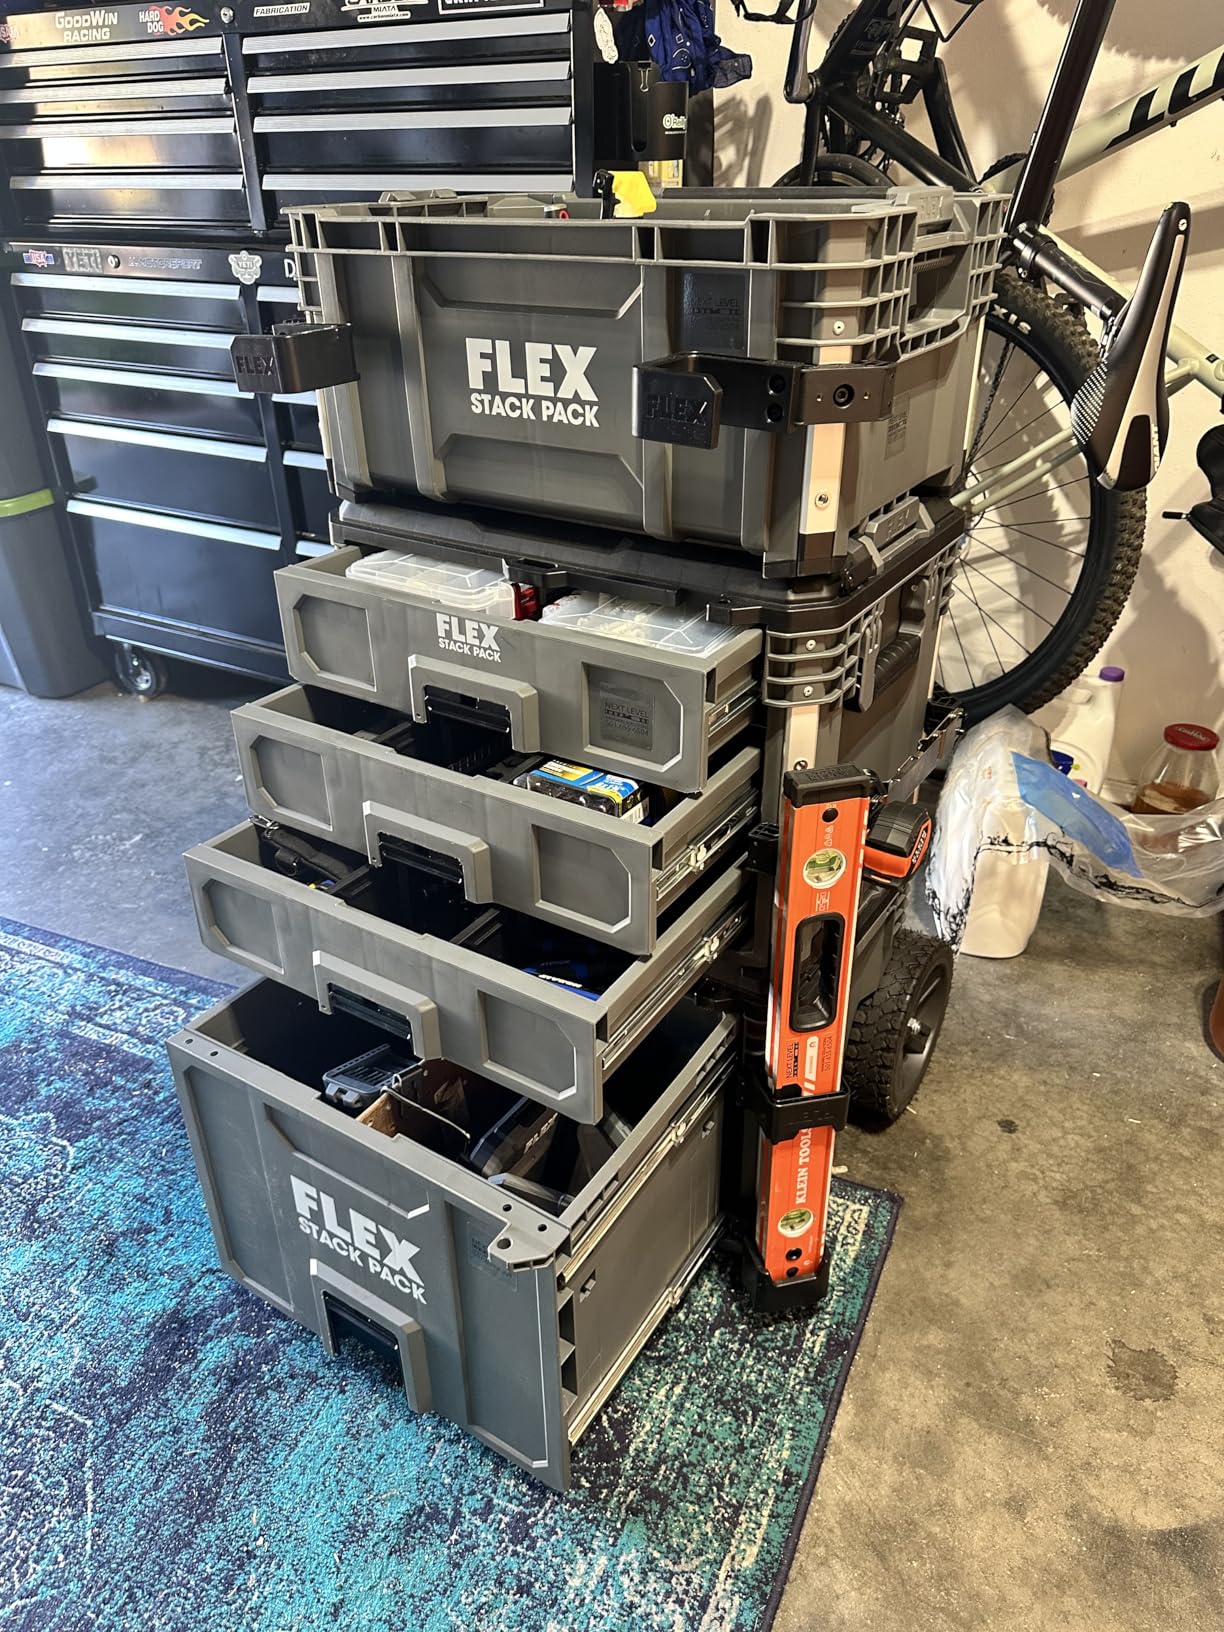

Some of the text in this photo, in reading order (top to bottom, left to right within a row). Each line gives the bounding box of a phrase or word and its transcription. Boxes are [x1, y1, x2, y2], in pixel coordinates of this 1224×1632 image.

[138, 10, 160, 23] HARD
[255, 5, 308, 16] FABRICATION
[373, 5, 396, 13] MIATA
[63, 28, 111, 42] RACING
[147, 21, 164, 33] DOG
[64, 251, 101, 270] YETI
[238, 260, 253, 269] YETI
[236, 354, 275, 376] FLEX
[465, 337, 599, 402] FLEX
[470, 392, 600, 428] STACK PACK
[436, 612, 500, 651] FLEX
[438, 637, 502, 663] STACK PACK
[795, 1167, 809, 1204] KLEIN
[290, 1175, 425, 1287] FLEX
[298, 1216, 427, 1304] STACK PACK
